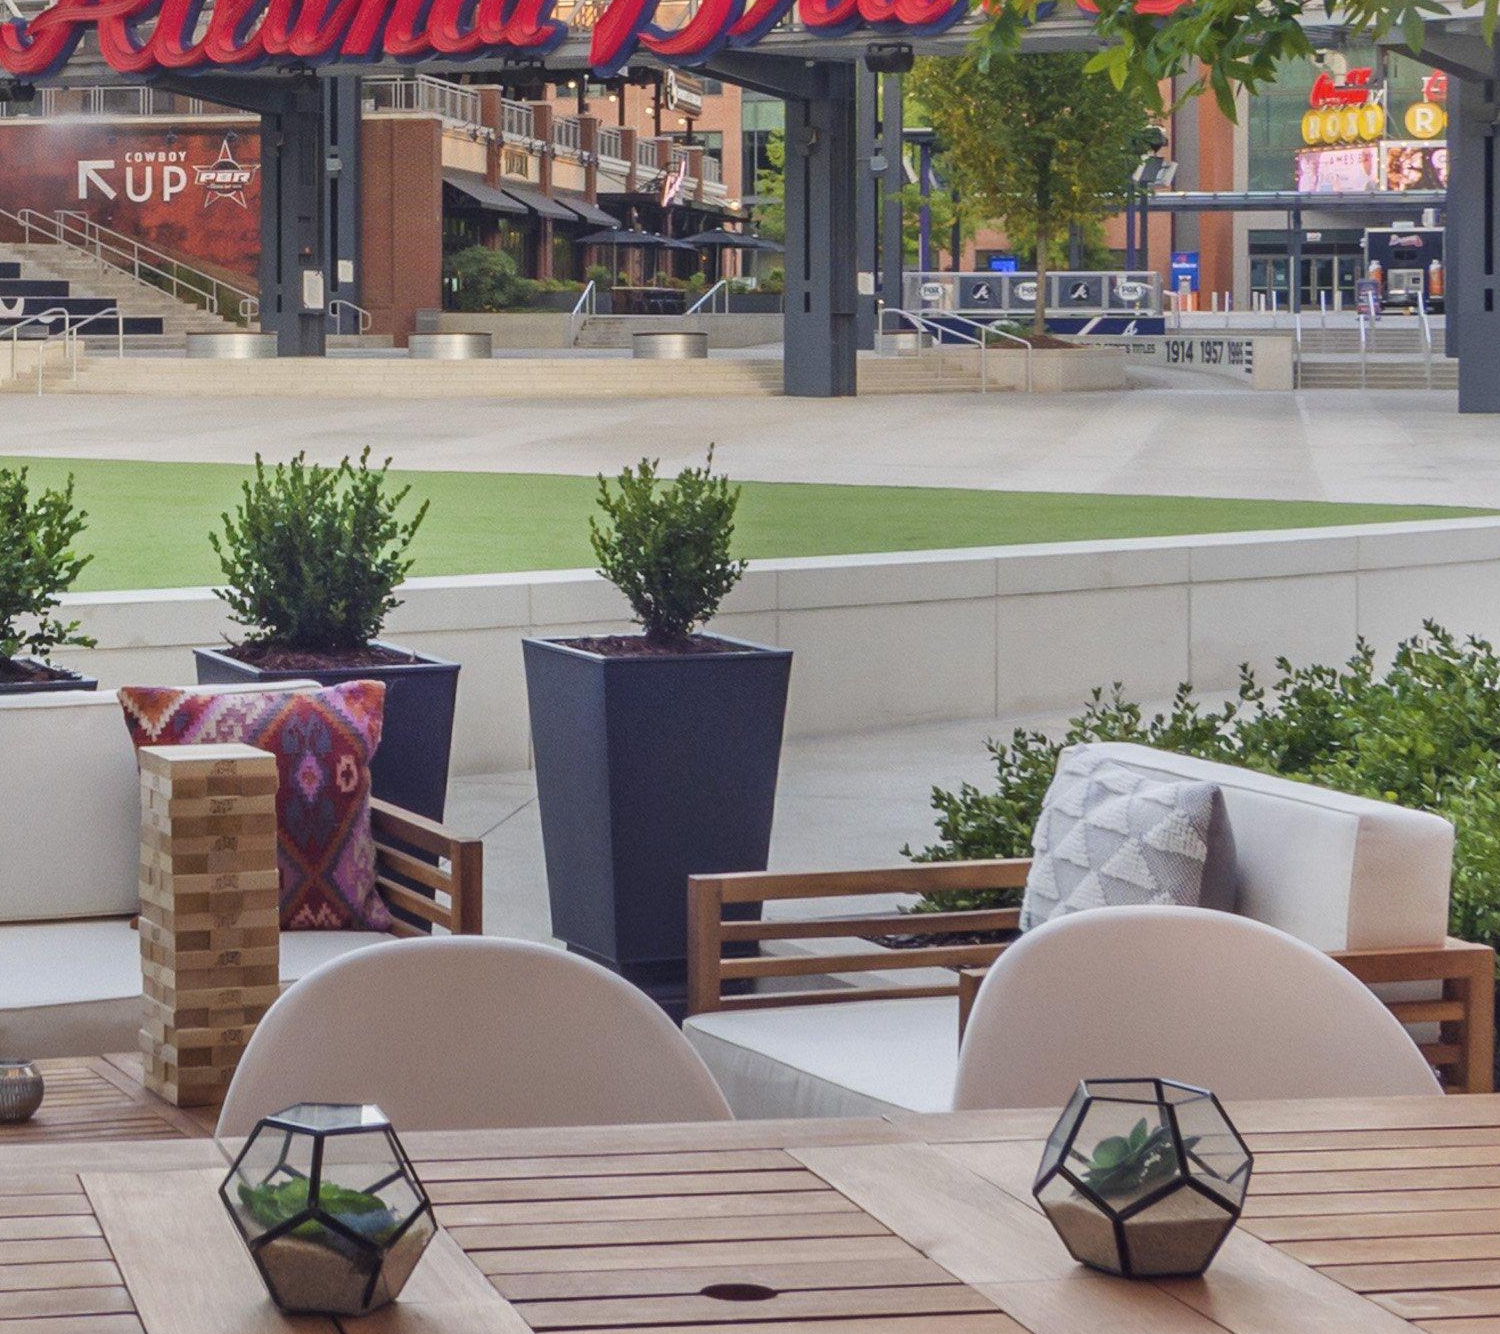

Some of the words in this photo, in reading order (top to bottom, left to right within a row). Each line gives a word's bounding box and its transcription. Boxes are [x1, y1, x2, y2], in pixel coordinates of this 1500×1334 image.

[125, 151, 188, 163] COWBOY
[126, 165, 188, 203] UP
[199, 171, 251, 183] PBR
[1165, 340, 1194, 363] 1914
[1200, 340, 1224, 364] 1957
